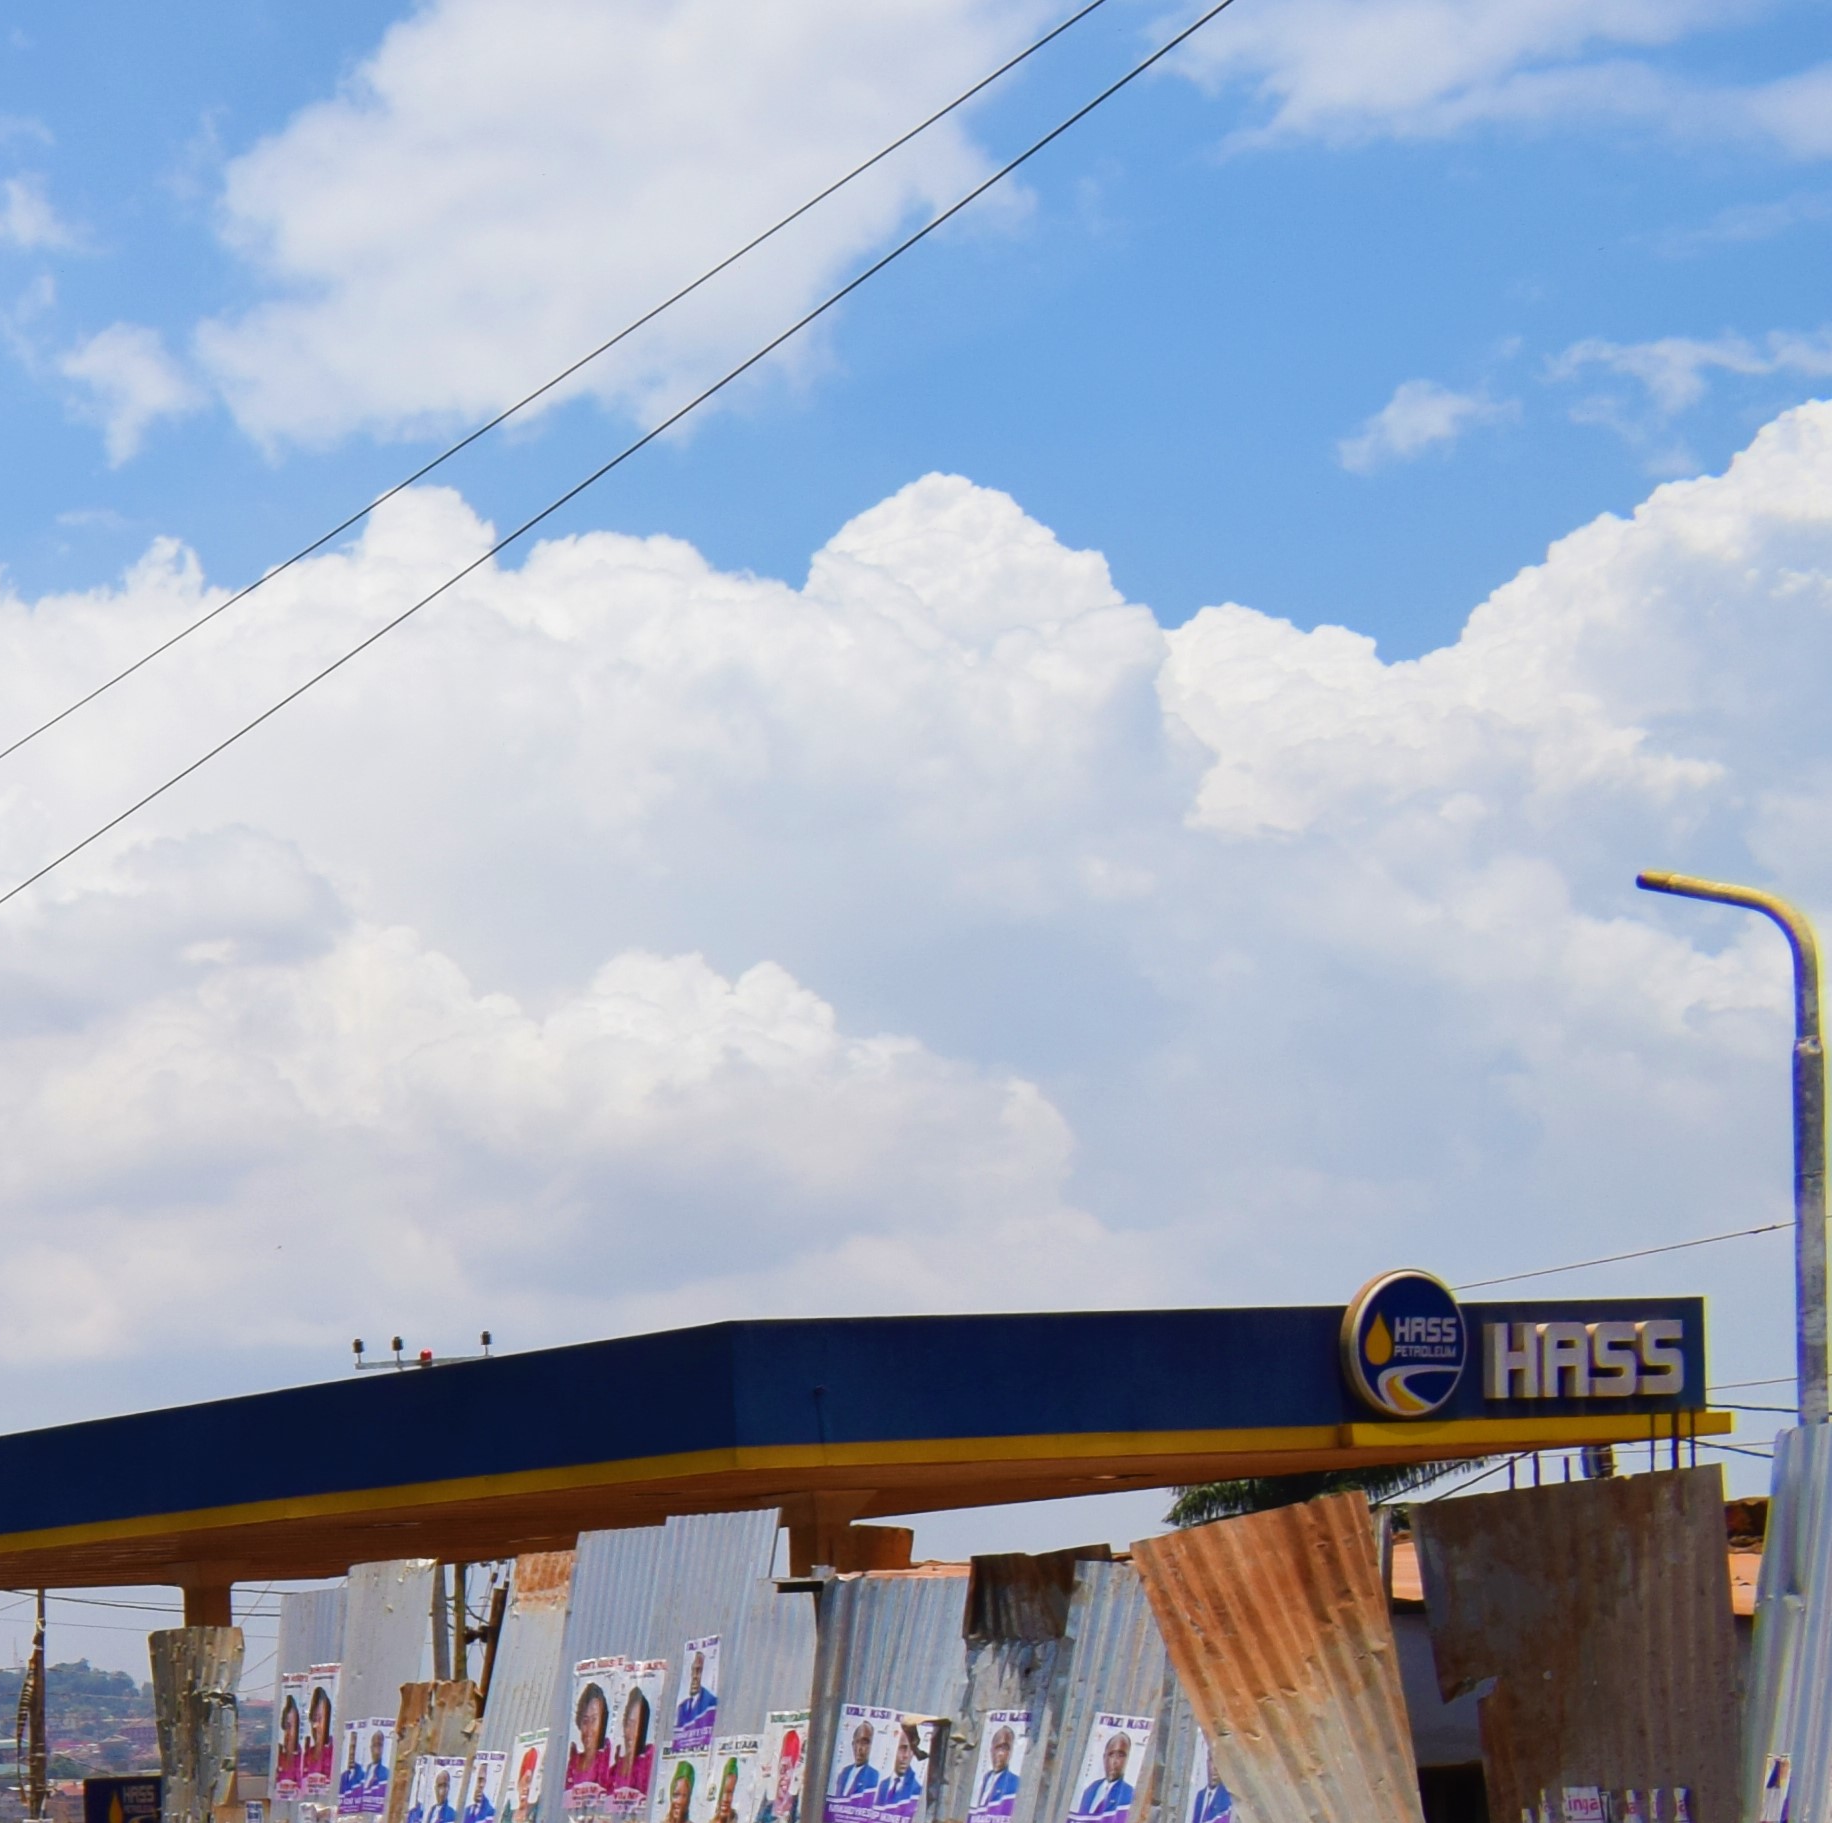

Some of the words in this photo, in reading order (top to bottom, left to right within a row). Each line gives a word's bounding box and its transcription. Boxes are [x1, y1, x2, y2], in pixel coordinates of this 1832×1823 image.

[1394, 1316, 1457, 1343] HASS
[1393, 1344, 1457, 1358] PETROLEUM
[1483, 1319, 1684, 1399] HASS
